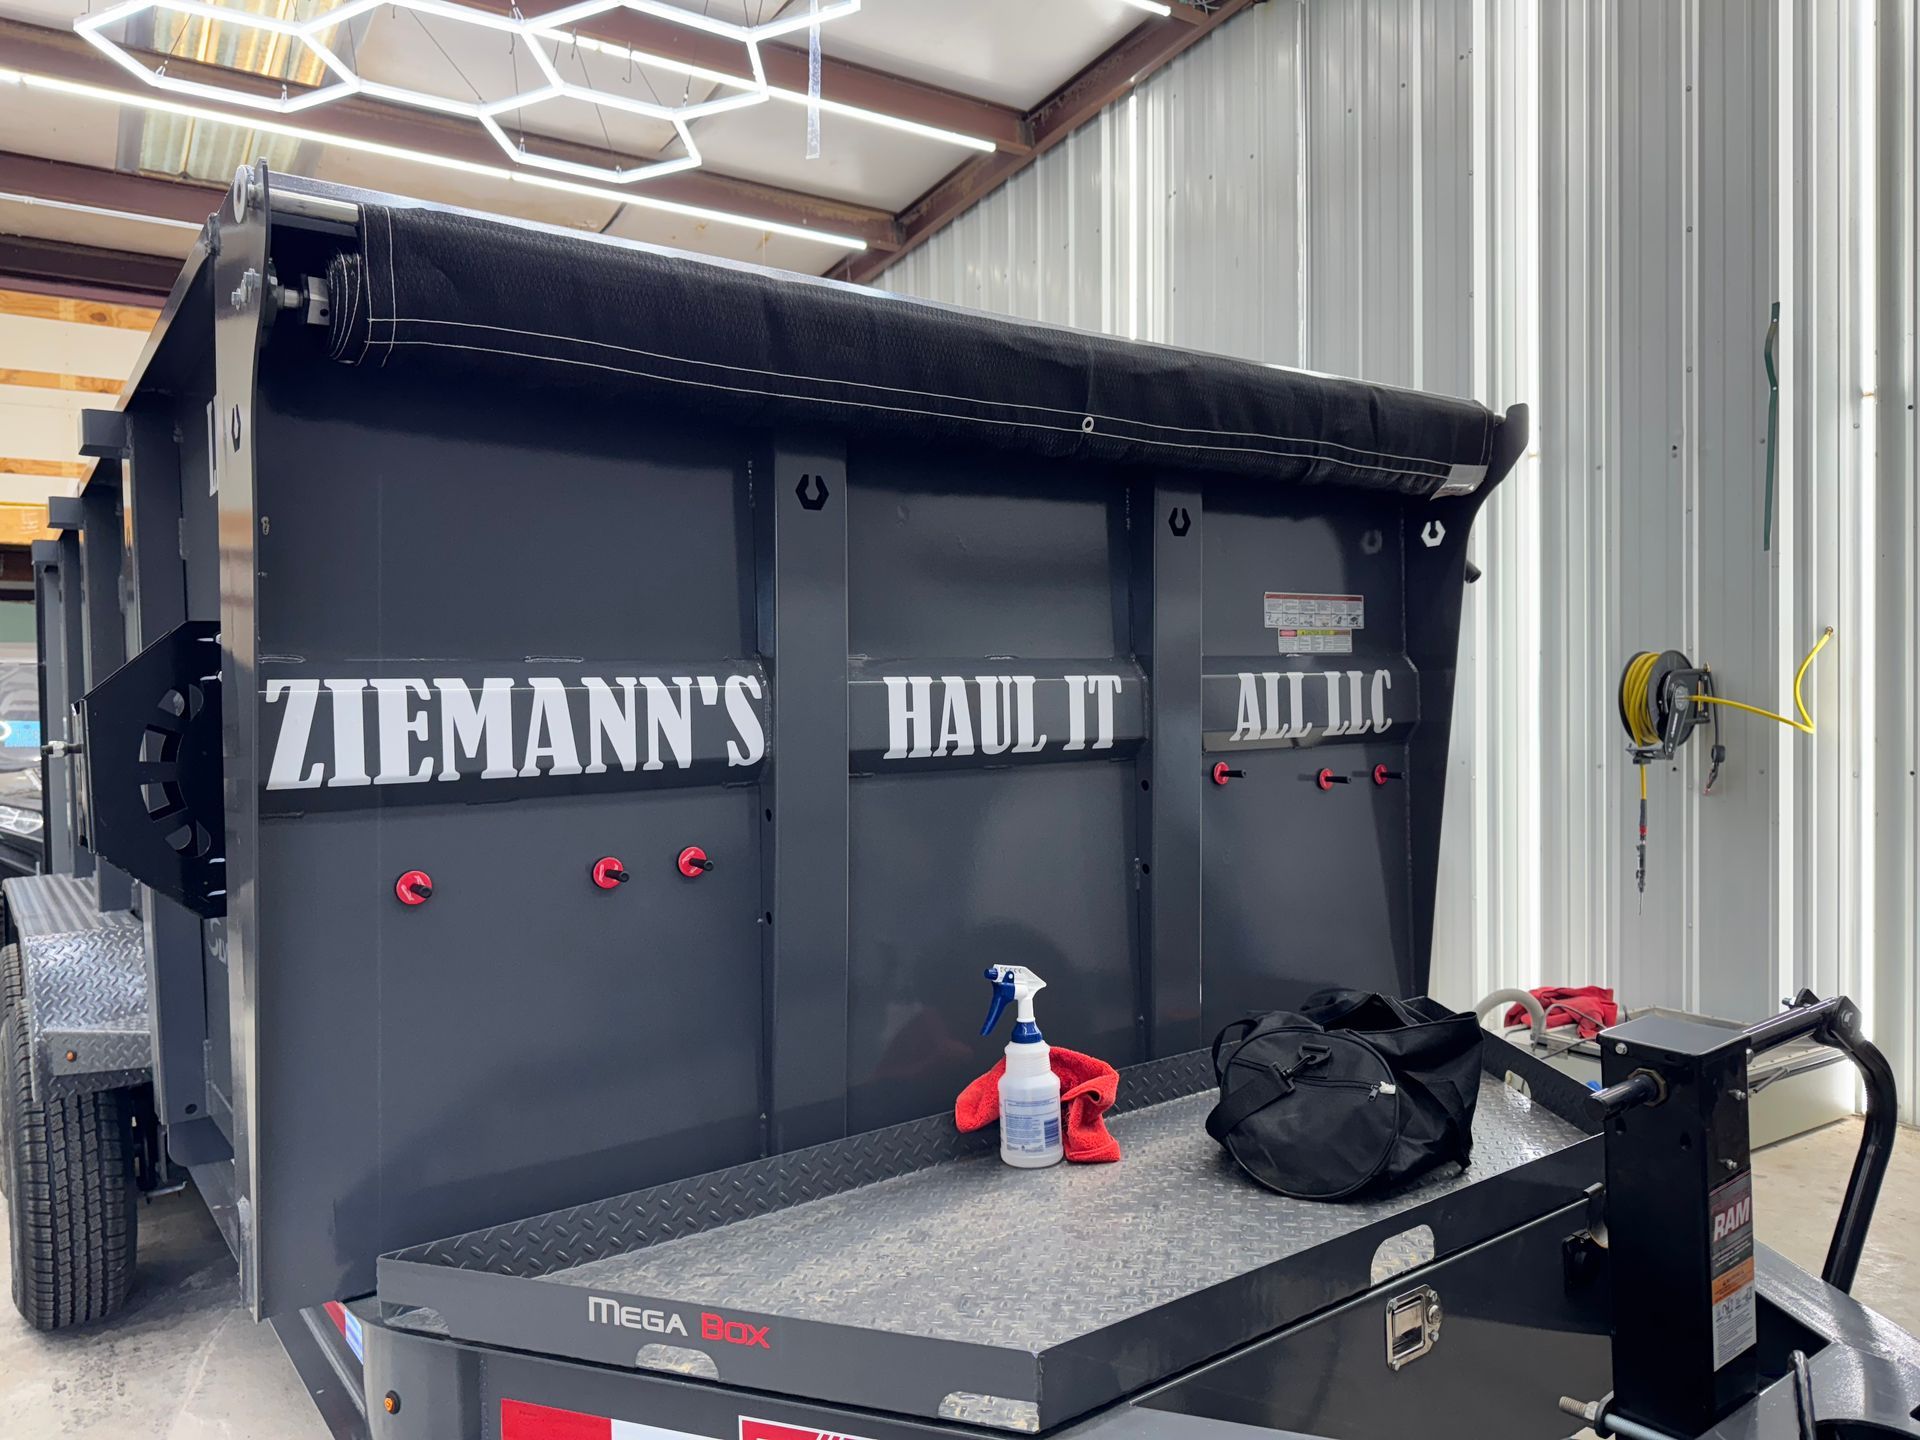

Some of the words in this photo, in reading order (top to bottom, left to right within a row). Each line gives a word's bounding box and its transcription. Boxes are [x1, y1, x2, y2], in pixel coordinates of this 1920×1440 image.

[266, 675, 766, 790] ZIEMANN'S
[883, 675, 1047, 760] HAUL
[1062, 674, 1122, 751] IT
[1229, 671, 1313, 742] ALL
[1321, 669, 1393, 736] LLC
[1713, 1197, 1751, 1242] RAM
[588, 1296, 689, 1337] MEGA
